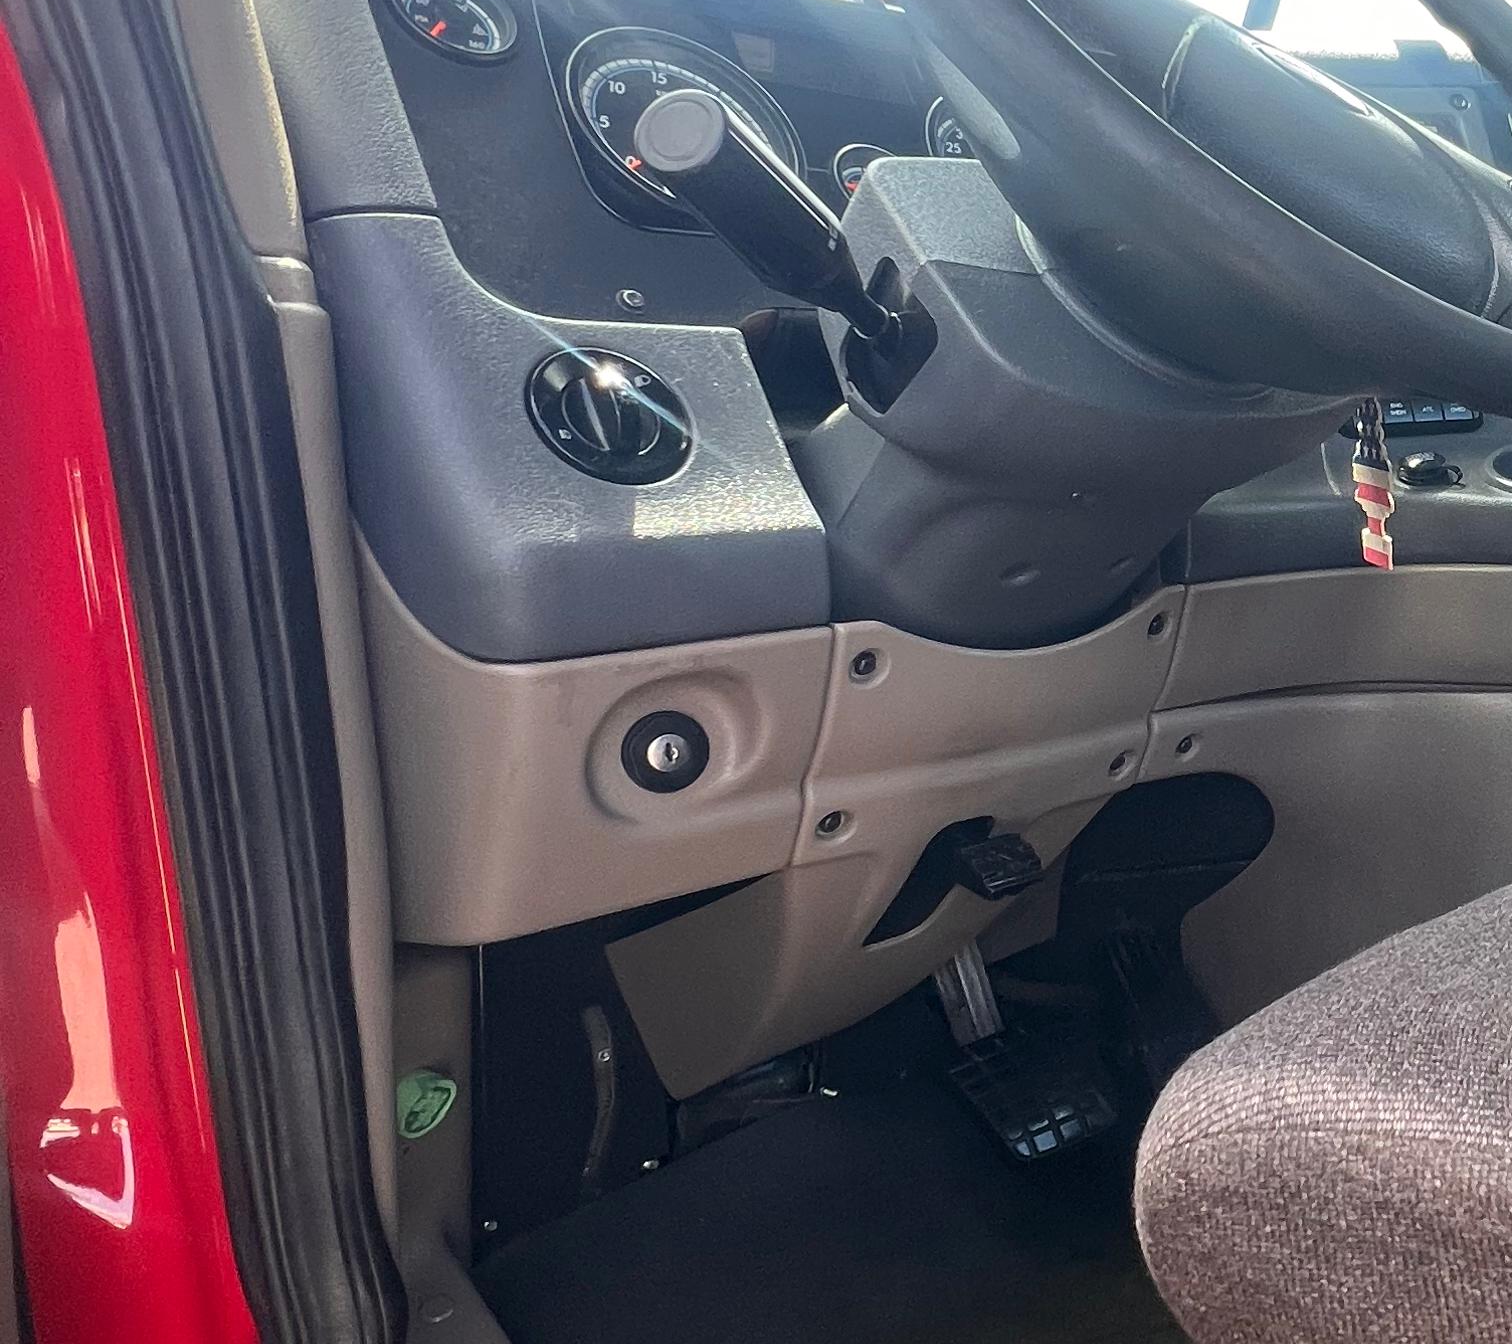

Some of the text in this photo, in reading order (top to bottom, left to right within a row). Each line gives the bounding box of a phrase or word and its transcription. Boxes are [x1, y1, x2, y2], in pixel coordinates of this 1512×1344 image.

[651, 71, 668, 85] 15
[607, 80, 625, 94] 10
[599, 115, 611, 128] 5
[945, 142, 962, 154] 25
